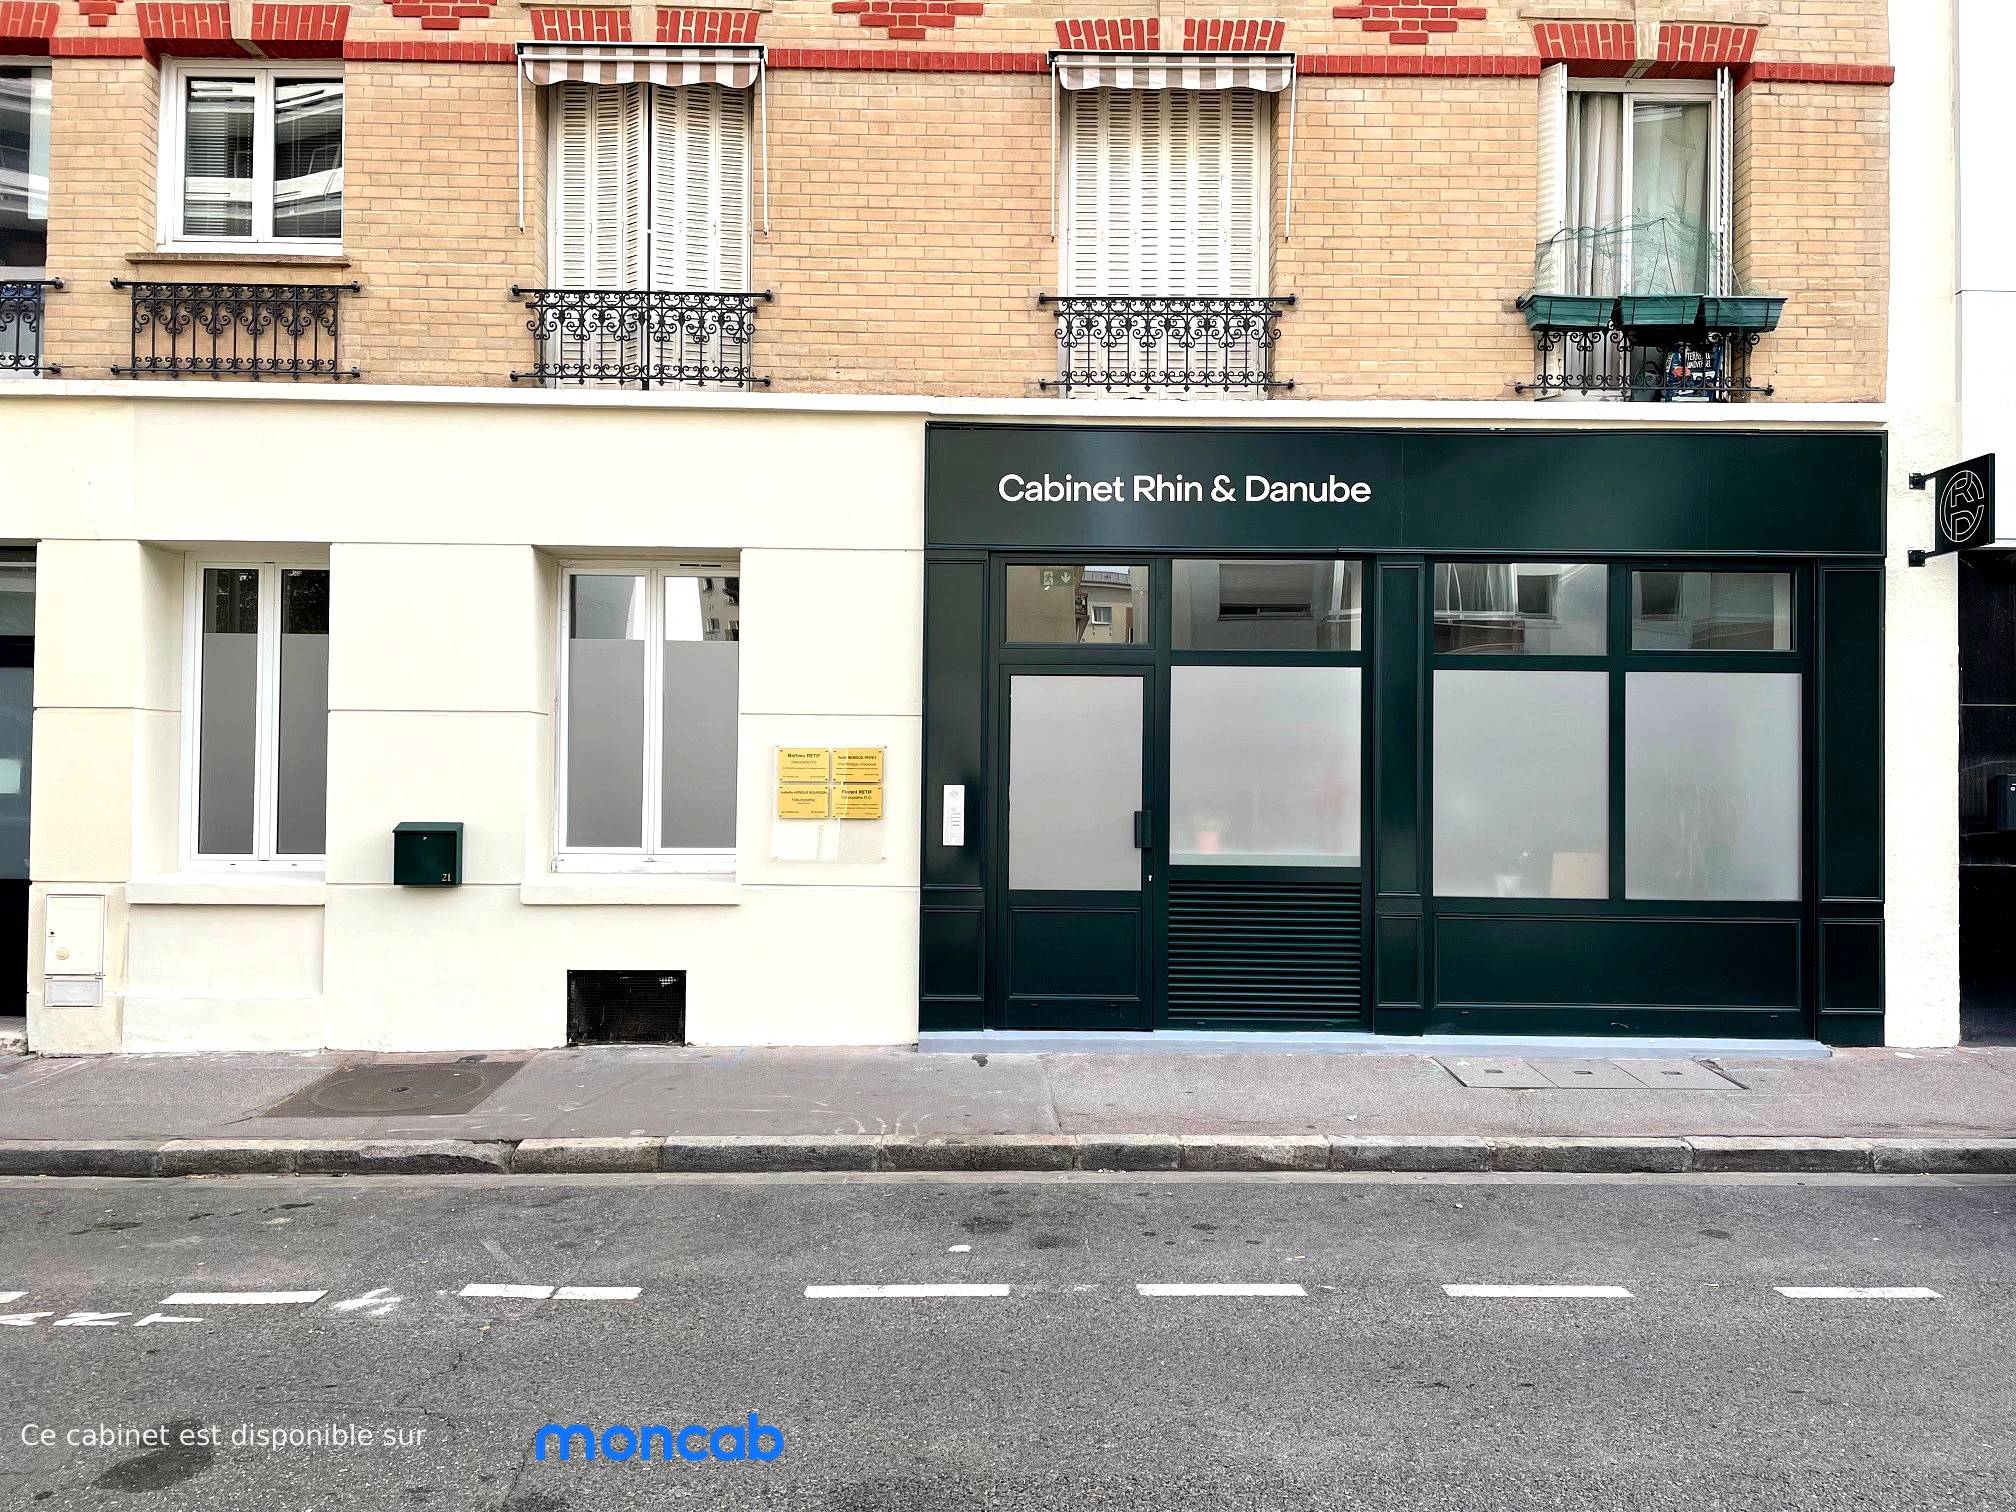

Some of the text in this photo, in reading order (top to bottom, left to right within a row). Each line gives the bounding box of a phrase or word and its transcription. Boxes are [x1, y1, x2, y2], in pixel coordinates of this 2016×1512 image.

[999, 474, 1371, 502] Cabinet Rhin & Danube
[441, 873, 451, 882] 21
